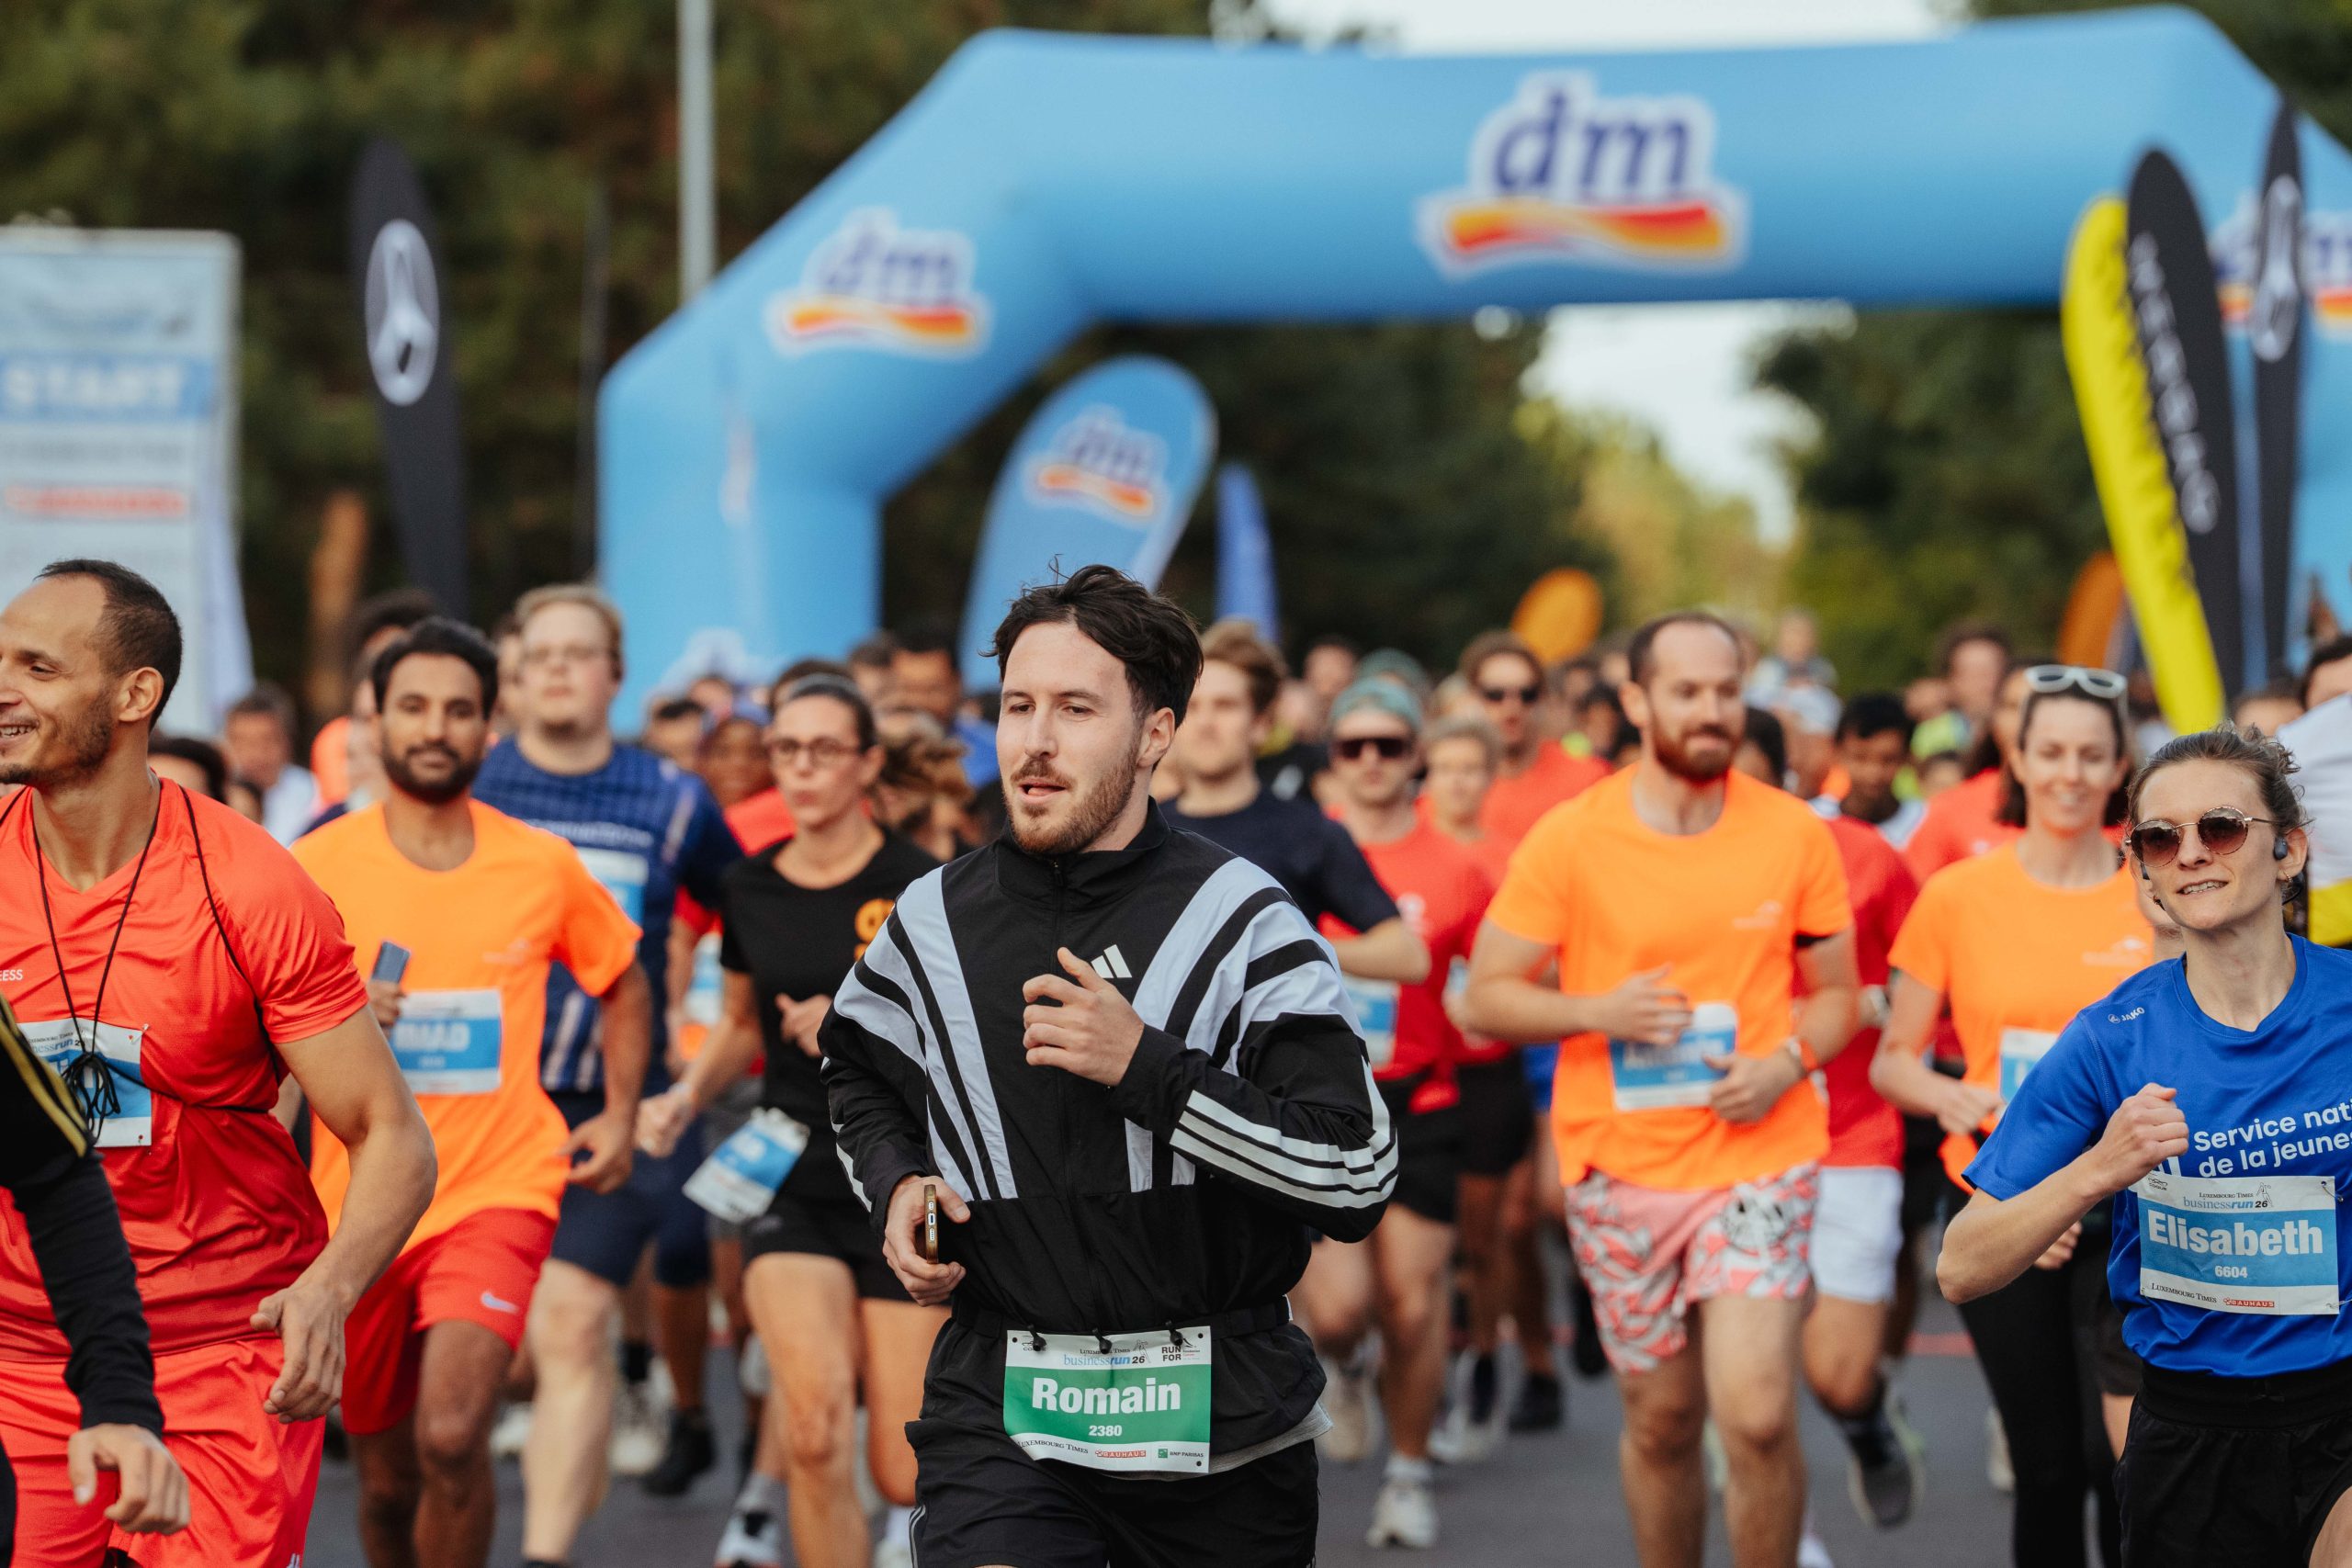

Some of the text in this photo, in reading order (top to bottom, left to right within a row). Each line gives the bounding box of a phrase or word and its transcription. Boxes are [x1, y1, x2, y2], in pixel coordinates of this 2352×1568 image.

[1493, 85, 1691, 195] dm
[2121, 1007, 2145, 1021] JAKO
[2193, 1116, 2297, 1152] Service
[2199, 1156, 2233, 1178] de
[2240, 1149, 2267, 1170] la
[2272, 1131, 2352, 1168] jeune
[2255, 1201, 2268, 1209] 26
[2147, 1209, 2324, 1257] Elisabeth
[2214, 1265, 2248, 1279] 6604
[1161, 1346, 1182, 1354] RUN
[1132, 1356, 1146, 1364] 26
[1032, 1377, 1181, 1415] Romain
[1088, 1425, 1123, 1437] 2380
